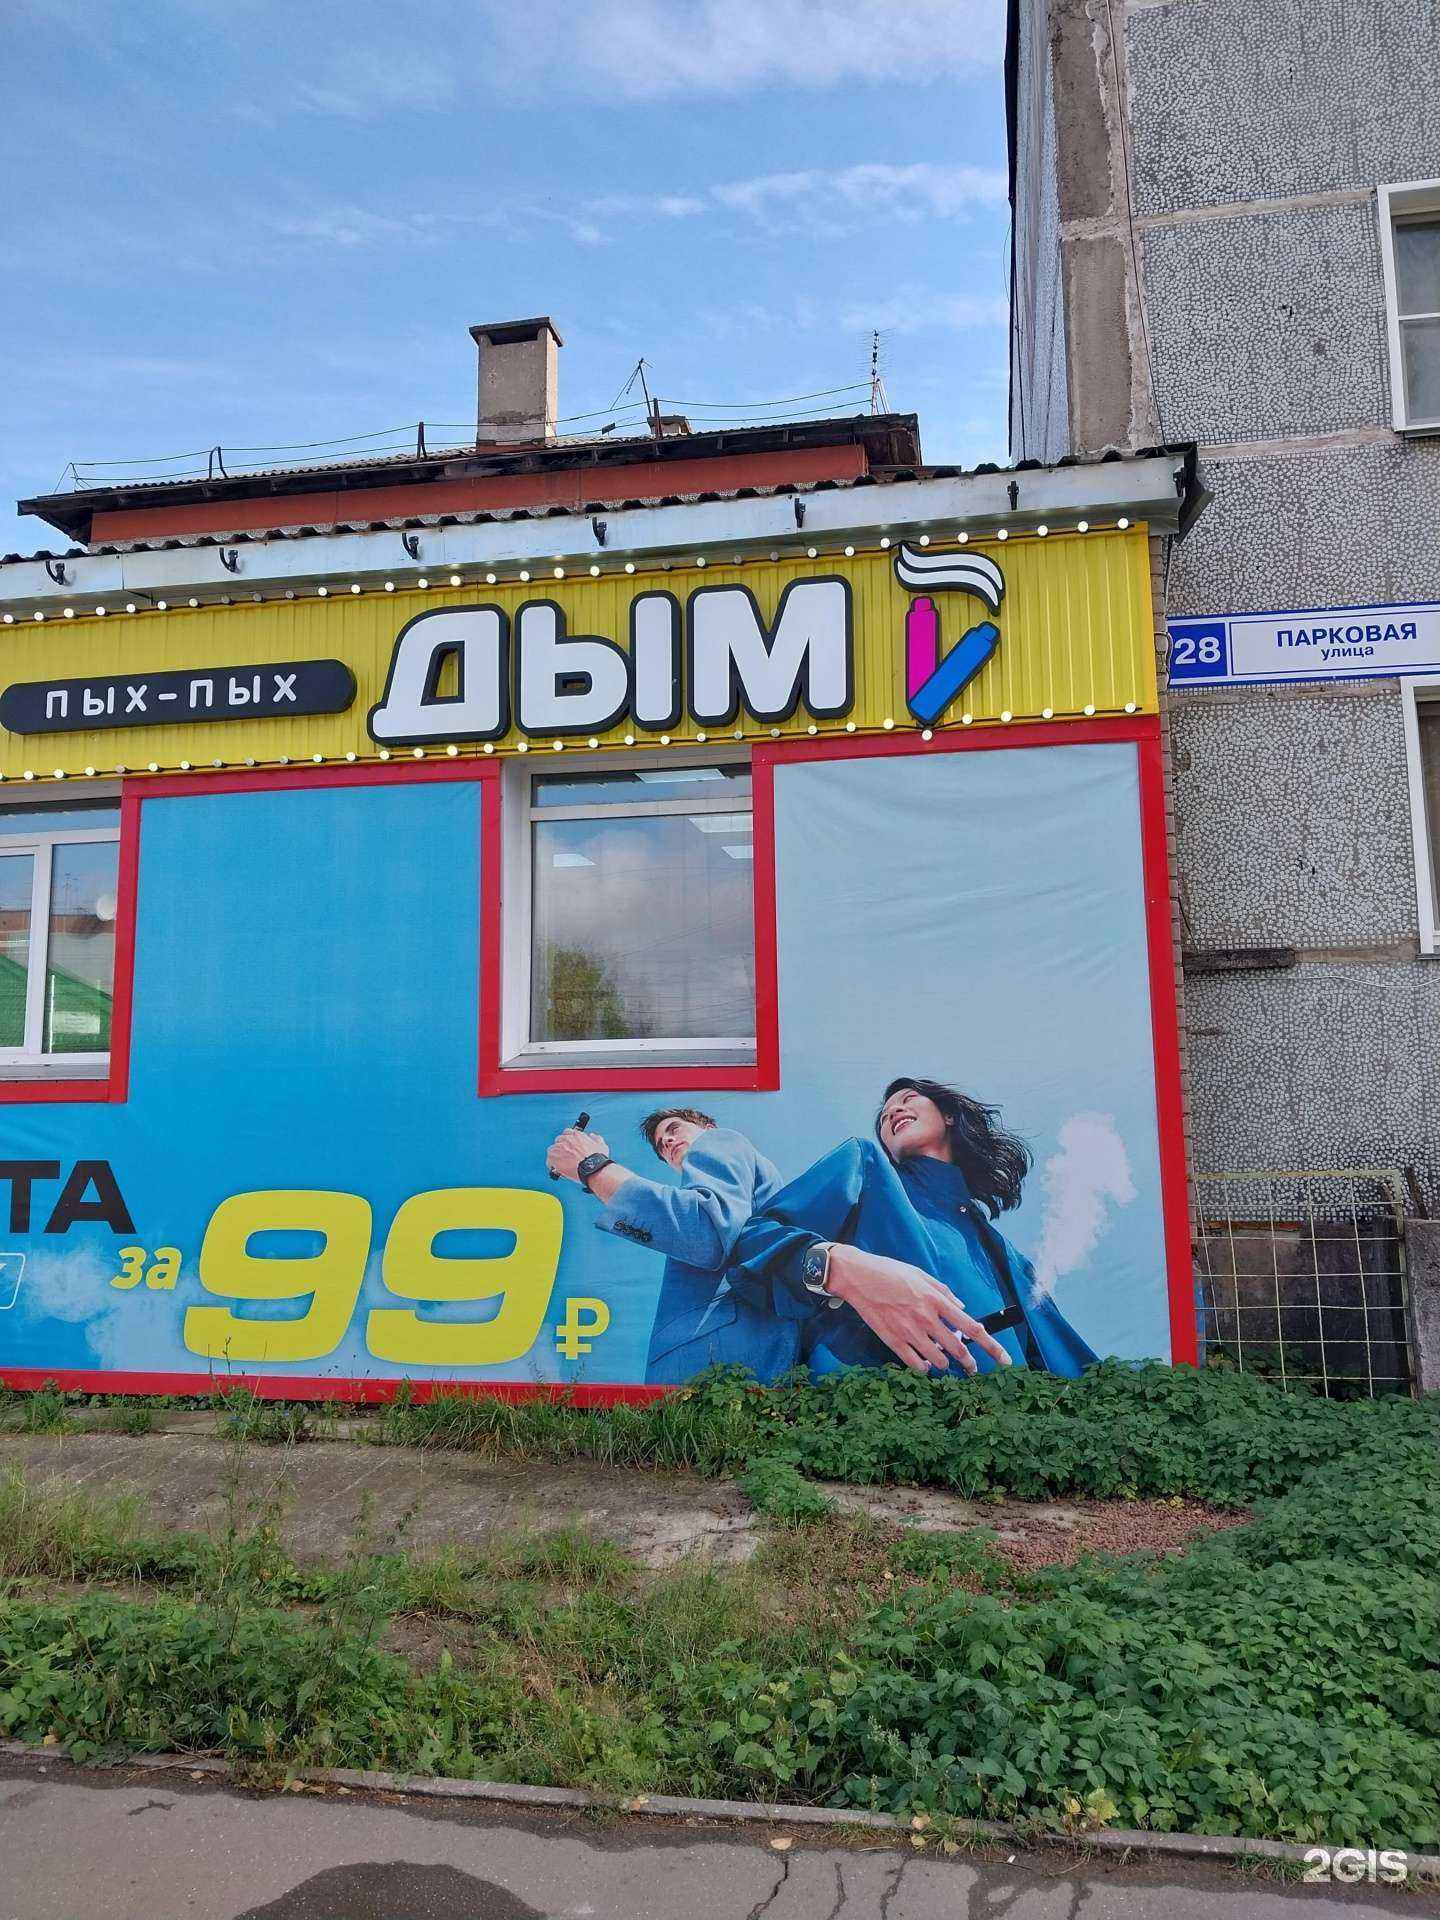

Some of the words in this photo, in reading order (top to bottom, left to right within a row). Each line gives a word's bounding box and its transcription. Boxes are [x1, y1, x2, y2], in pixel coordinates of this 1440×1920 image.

[1174, 636, 1221, 665] 28
[1277, 622, 1417, 647] ПАРКОВАЯ
[1321, 645, 1375, 661] улица
[368, 575, 853, 745] ДЫМ
[46, 673, 297, 719] ПЫХ-ПЫХ
[110, 1246, 182, 1290] за
[183, 1188, 564, 1366] 99
